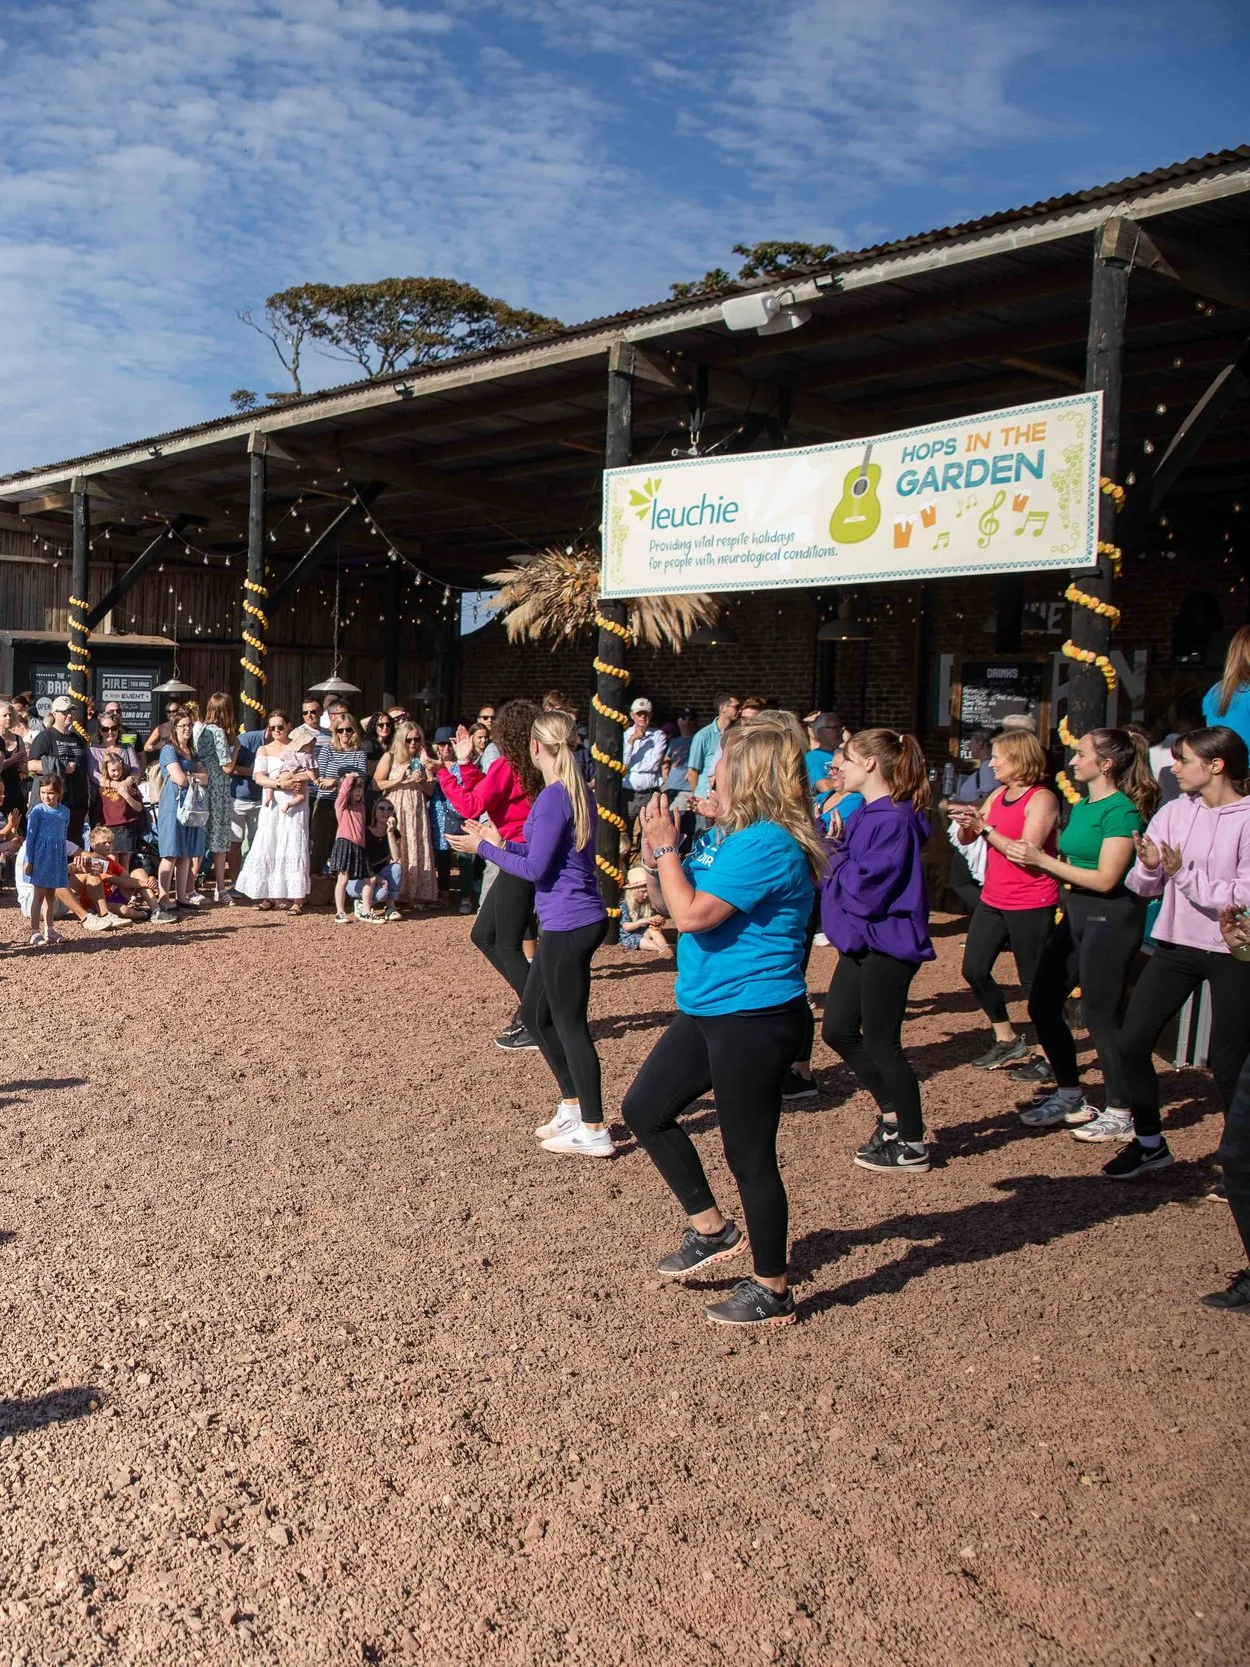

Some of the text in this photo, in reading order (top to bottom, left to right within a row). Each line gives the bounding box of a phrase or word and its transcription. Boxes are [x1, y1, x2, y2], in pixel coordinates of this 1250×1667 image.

[901, 421, 1047, 464] HOPS IN THE
[896, 449, 1046, 497] GARDEN
[650, 493, 739, 530] leuchie
[650, 530, 795, 555] Providing vital respite holidays
[649, 544, 838, 574] for people with neurological conditions.
[102, 678, 128, 689] HIRE
[987, 668, 1018, 679] DRINKS
[47, 680, 71, 695] BAR
